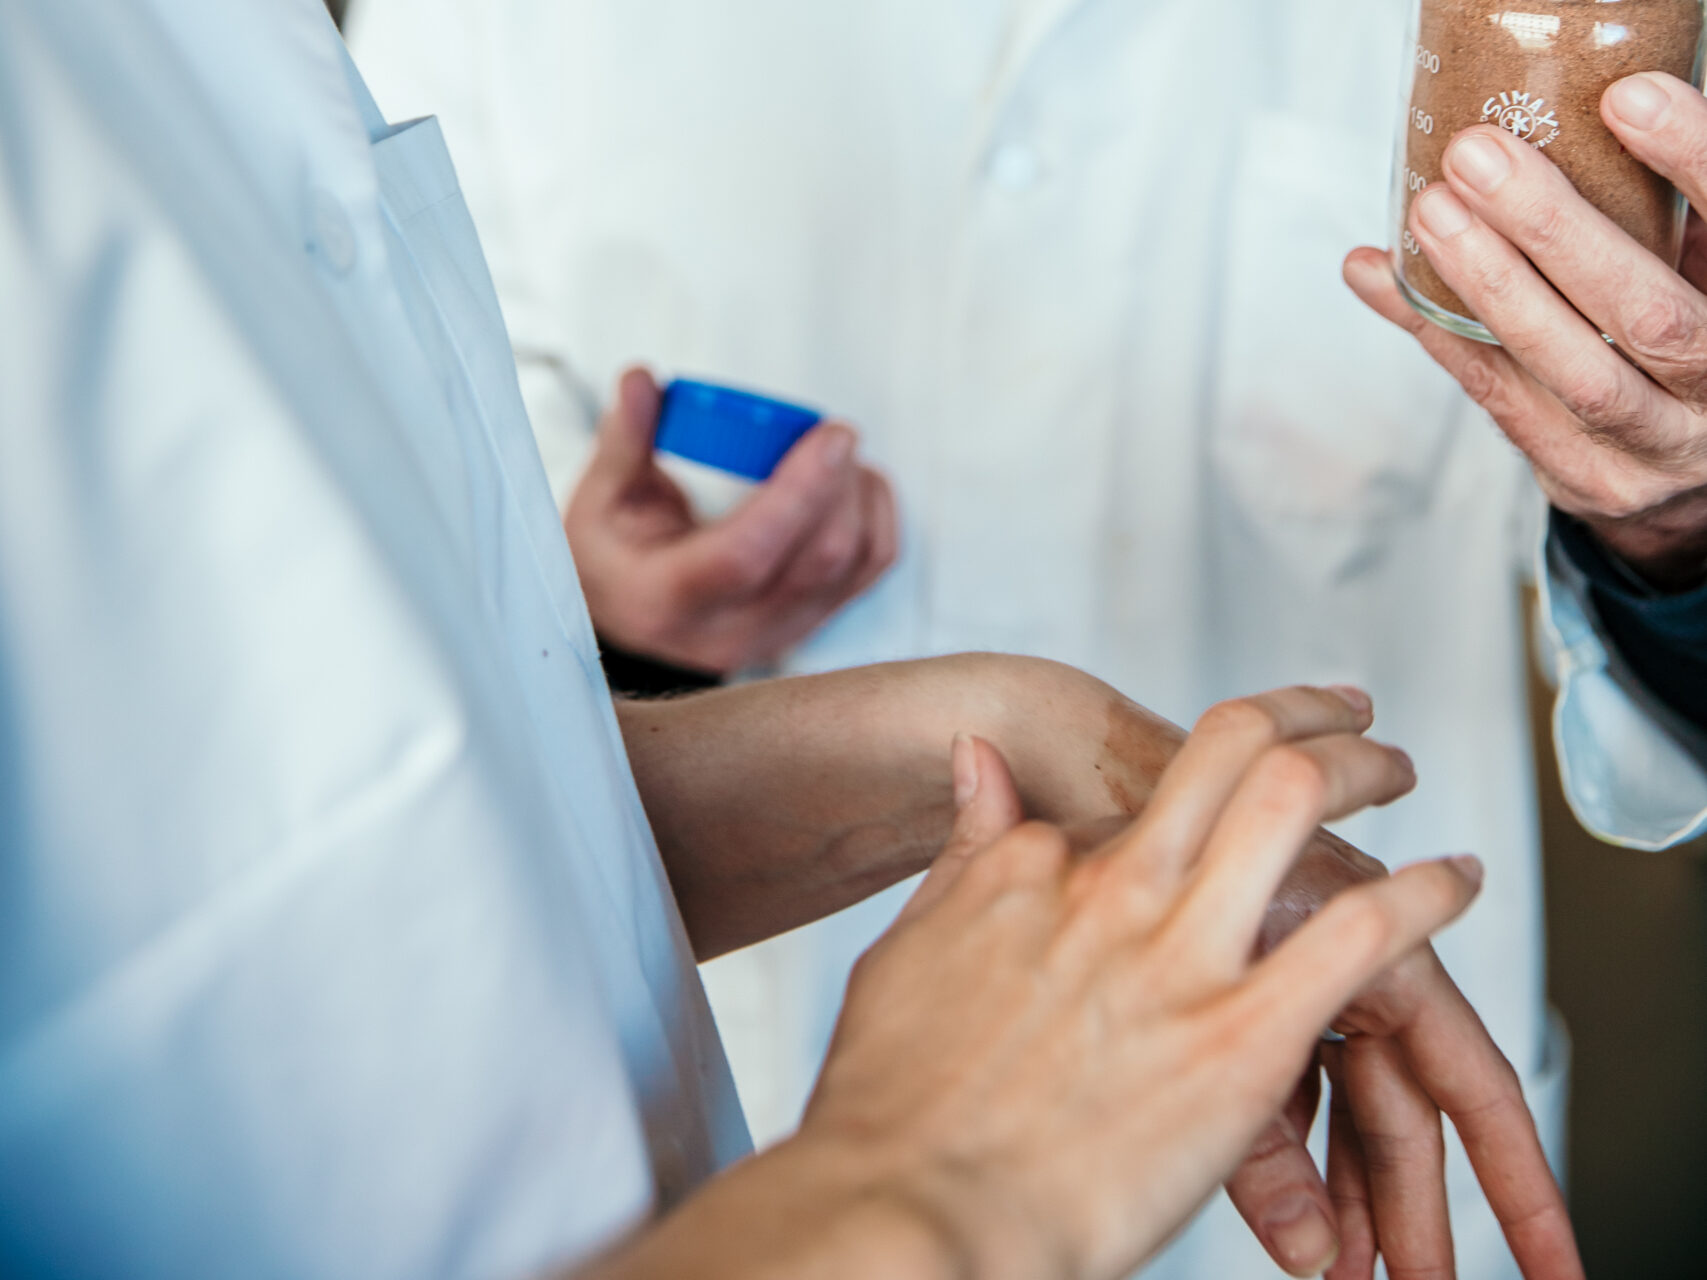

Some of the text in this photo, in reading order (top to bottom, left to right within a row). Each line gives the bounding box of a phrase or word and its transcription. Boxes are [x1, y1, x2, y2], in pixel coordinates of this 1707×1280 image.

[1416, 45, 1440, 73] 200
[1411, 106, 1433, 135] 150
[1482, 90, 1559, 128] SIMAX
